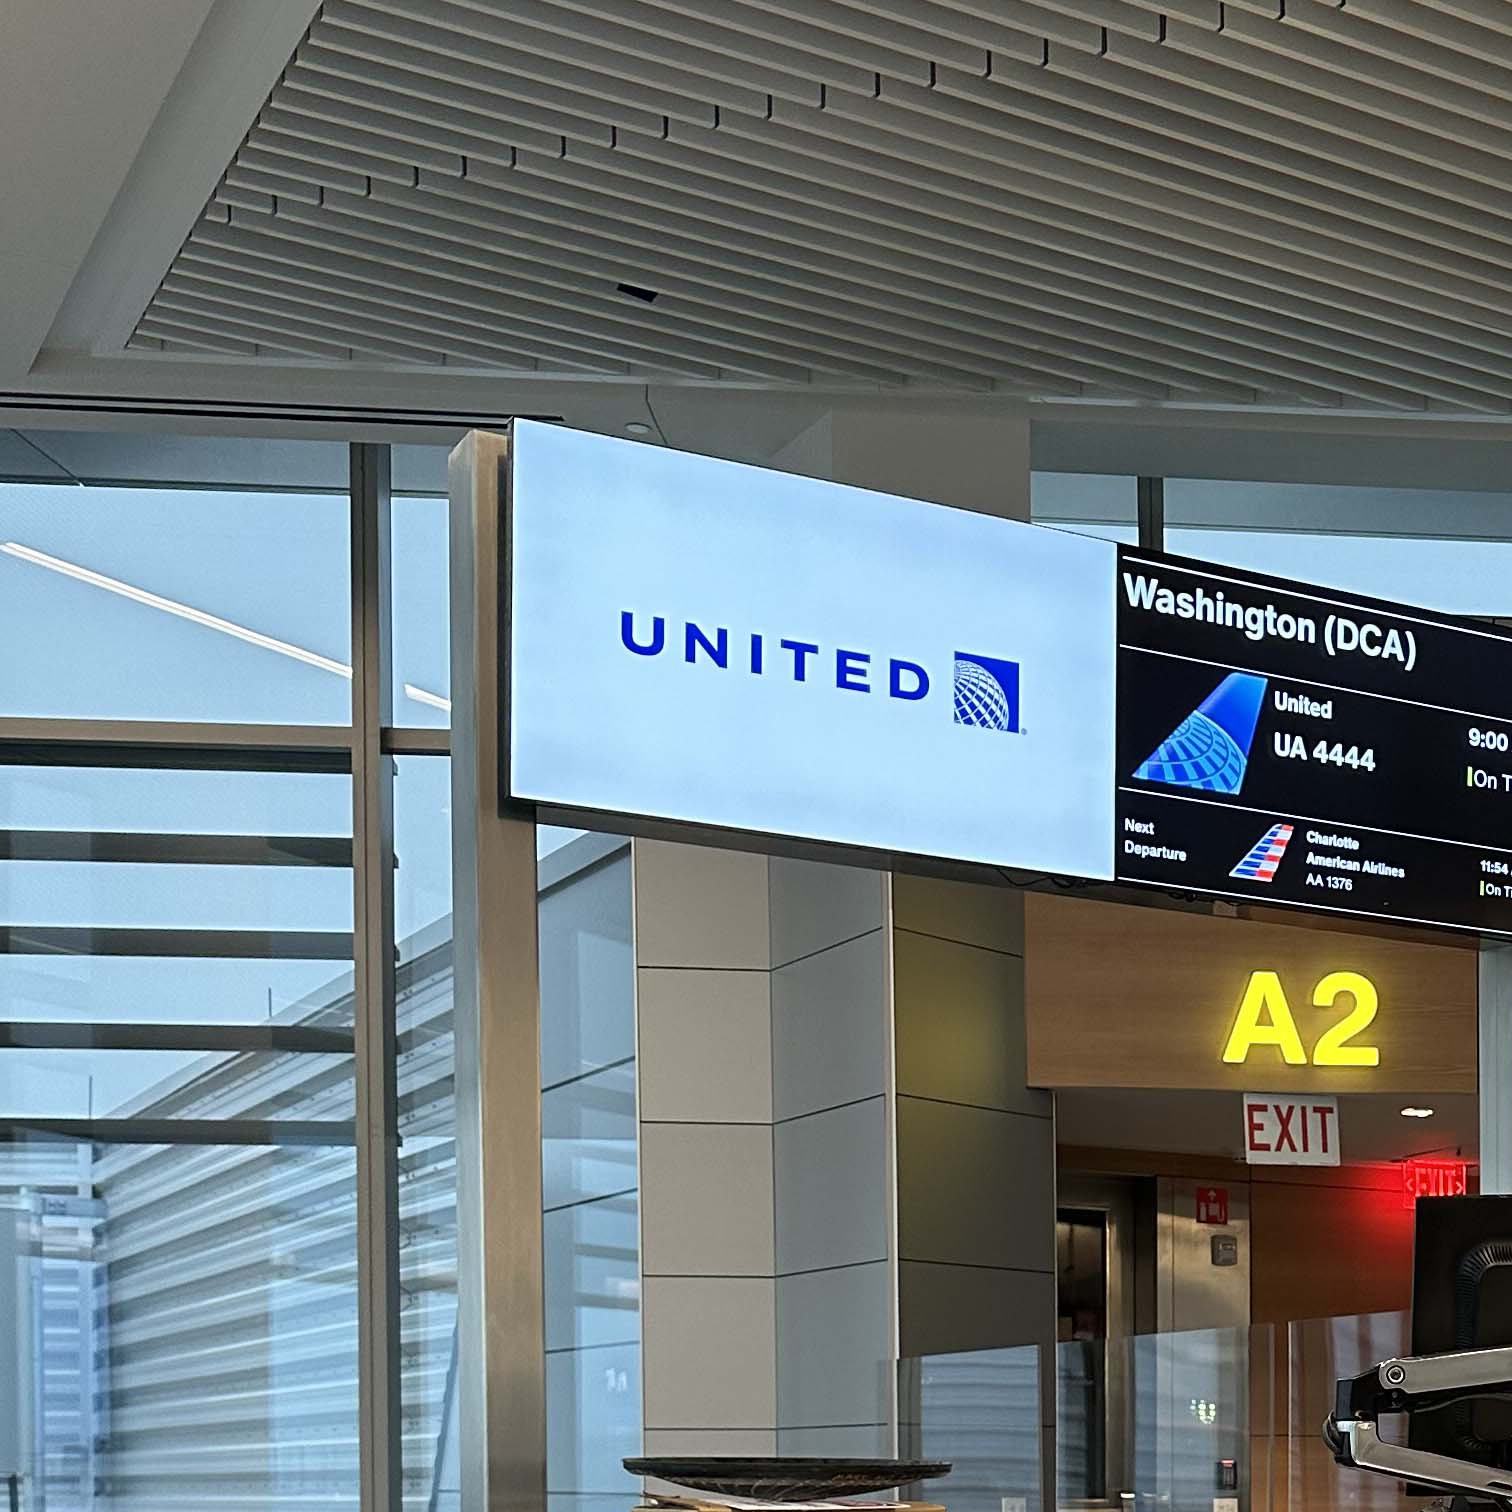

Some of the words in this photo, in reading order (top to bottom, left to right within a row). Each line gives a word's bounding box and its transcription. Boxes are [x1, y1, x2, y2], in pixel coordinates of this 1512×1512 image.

[1123, 573, 1315, 643] Washington
[1325, 615, 1416, 671] (DCA)
[620, 610, 930, 701] UNITED
[1275, 691, 1333, 720] United
[1275, 732, 1307, 760] UA
[1313, 741, 1376, 772] 4444
[1469, 728, 1508, 754] 9:00
[1474, 768, 1497, 790] On
[1125, 818, 1155, 836] Next
[1306, 830, 1360, 850] Charlotte
[1124, 840, 1187, 862] Departure
[1306, 852, 1360, 873] American
[1362, 860, 1405, 879] Airlines
[1480, 859, 1510, 877] 11:54
[1306, 873, 1324, 887] AA
[1326, 875, 1353, 891] 1376
[1486, 882, 1502, 898] On
[1222, 971, 1380, 1067] A2
[1247, 1103, 1334, 1154] EXIT
[1415, 1168, 1456, 1197] EXIT
